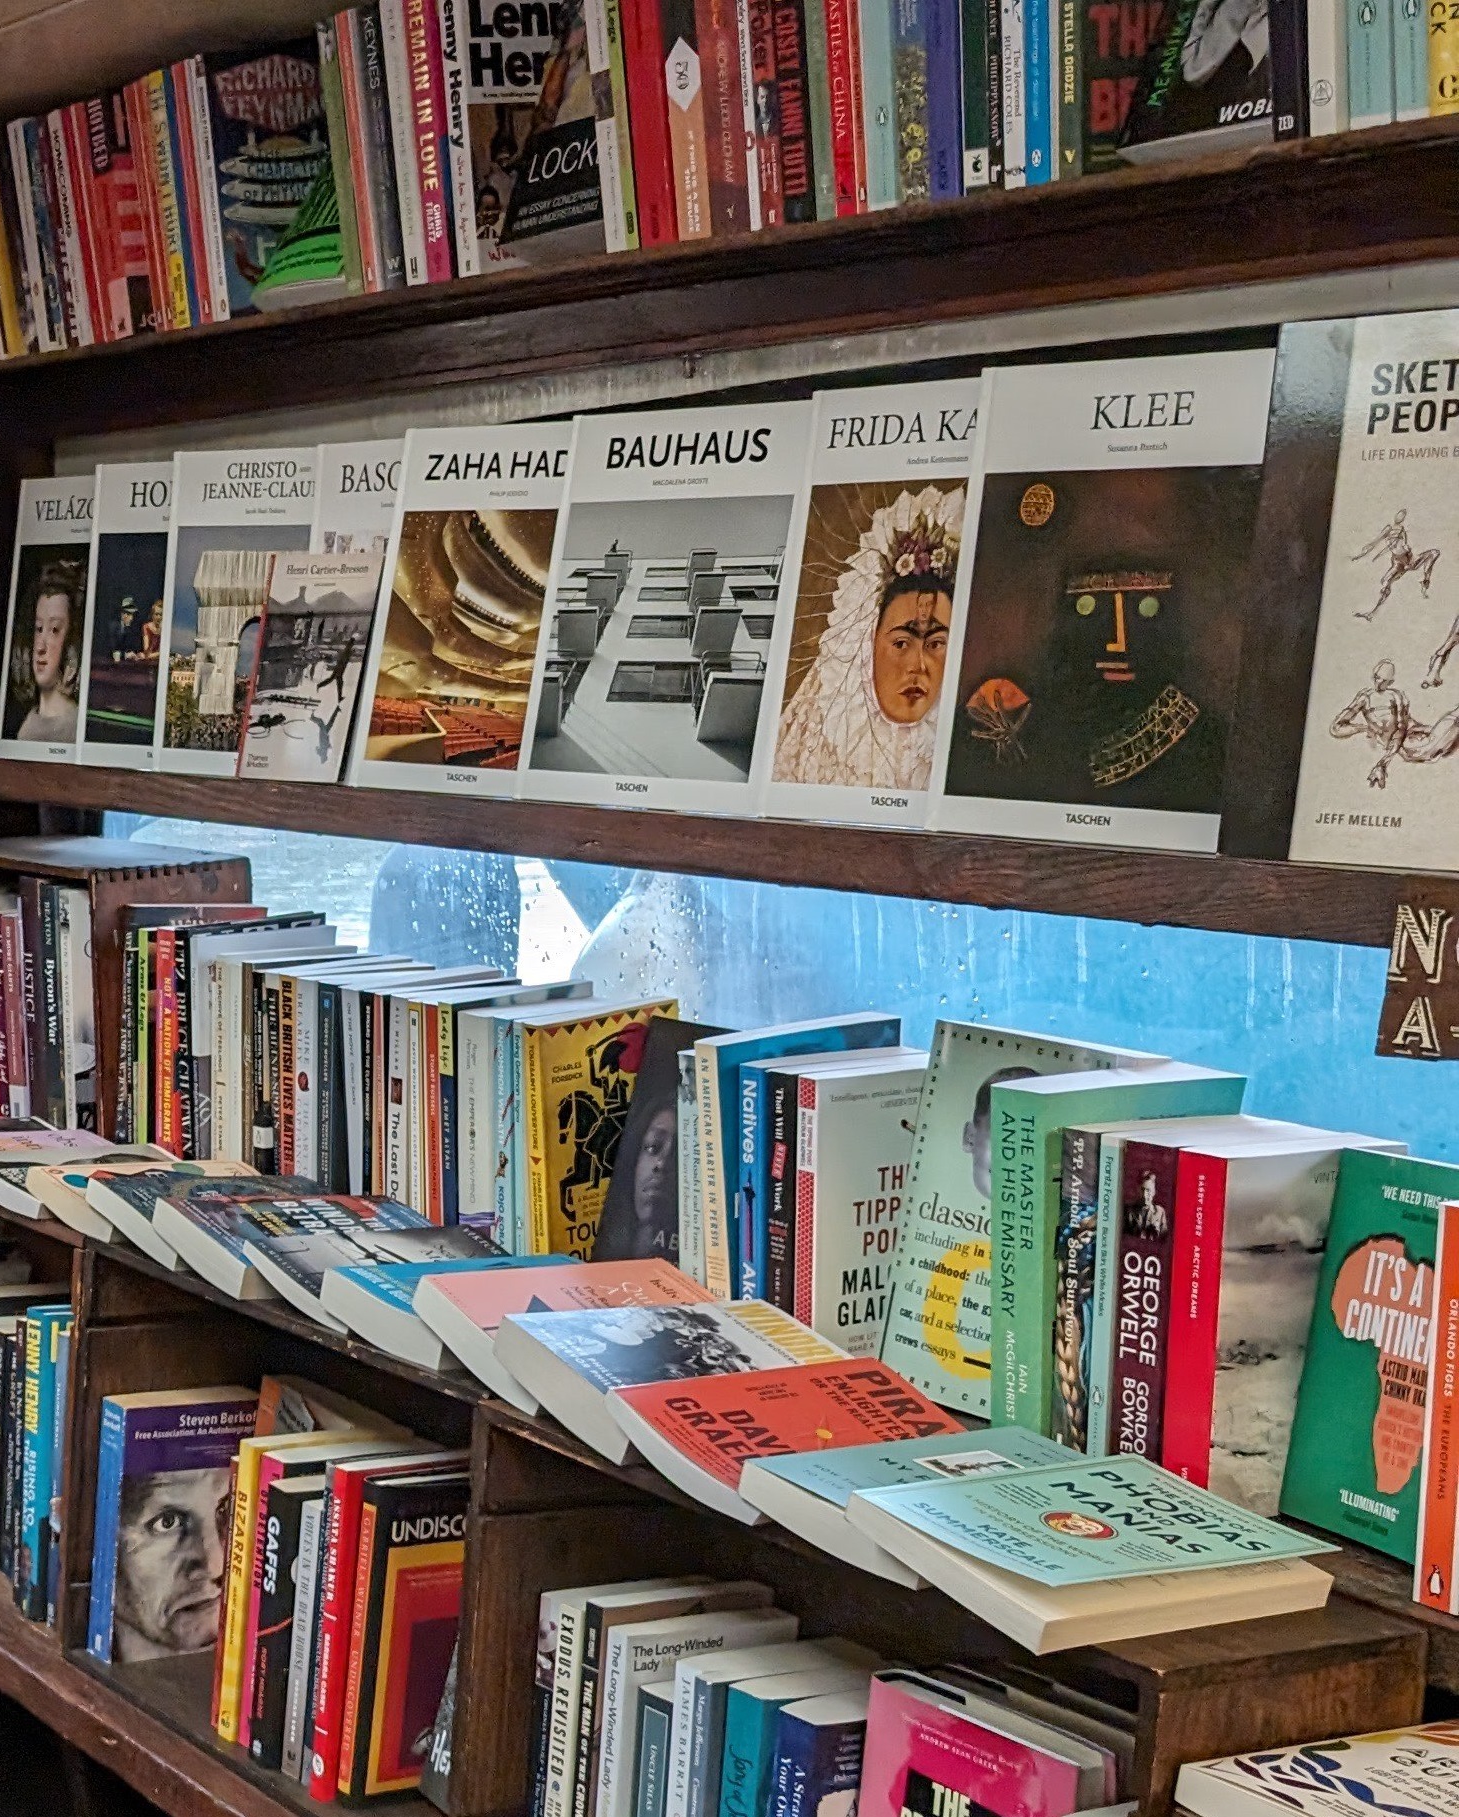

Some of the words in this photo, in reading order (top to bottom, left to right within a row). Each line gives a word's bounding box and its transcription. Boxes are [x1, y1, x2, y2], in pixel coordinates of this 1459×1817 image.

[775, 7, 800, 70] COSEY
[1063, 2, 1075, 53] STELLA
[363, 15, 381, 90] KEYNES
[1003, 35, 1012, 93] RICHARD
[1013, 49, 1022, 68] The
[1064, 55, 1076, 104] DADZIE
[415, 99, 433, 126] IN
[446, 68, 466, 149] Henry
[779, 78, 805, 136] FANNI
[833, 76, 849, 139] CHINA
[418, 132, 439, 191] LOVE
[527, 138, 600, 184] LOCK
[783, 140, 808, 195] TUTTI
[424, 201, 437, 244] FRANTZ
[433, 203, 443, 238] CHRIS
[1089, 390, 1197, 432] KLEE
[604, 427, 772, 470] BAUHAUS
[826, 411, 925, 450] FRIDA
[227, 460, 297, 479] CHRISTO
[423, 451, 502, 482] ZAHA
[1361, 449, 1385, 462] LIFE
[1388, 446, 1448, 461] DRAWING
[445, 772, 478, 784] TASCHEN
[614, 781, 649, 793] TASCHEN
[869, 795, 909, 809] TASCHEN
[1065, 812, 1112, 827] TASCHEN
[1314, 812, 1345, 826] JEFF
[1347, 813, 1404, 828] MELLEM
[43, 900, 52, 946] BEATON
[42, 958, 58, 1013] Byron's
[139, 956, 147, 989] Arms
[281, 980, 292, 1021] BLACK
[47, 1015, 59, 1046] War
[137, 1006, 147, 1032] Legs
[162, 1017, 172, 1058] NATION
[282, 1024, 293, 1073] BRITISH
[303, 1029, 311, 1065] MIKE
[513, 1034, 521, 1059] Erving
[162, 1059, 172, 1073] OF
[497, 1025, 506, 1096] UNCOMMON
[514, 1060, 522, 1097] Goffman
[550, 1071, 583, 1085] FORSDICK
[551, 1061, 583, 1074] CHARLES
[700, 1056, 709, 1073] AN
[162, 1075, 172, 1143] IMMIGRANTS
[282, 1076, 294, 1110] LIVES
[701, 1077, 714, 1136] AMERICAN
[774, 1087, 785, 1114] That
[390, 1111, 401, 1142] The
[443, 1097, 451, 1132] AHMET
[741, 1079, 757, 1164] Natives
[774, 1116, 785, 1140] Will
[1001, 1110, 1018, 1160] AND
[1019, 1114, 1036, 1160] THE
[390, 1144, 400, 1177] Last
[443, 1137, 451, 1171] ALTAN
[1070, 1137, 1085, 1172] P.P.
[1103, 1155, 1114, 1187] Frantz
[497, 1185, 506, 1213] KOJO
[707, 1191, 717, 1205] IN
[773, 1181, 783, 1212] Work
[1002, 1165, 1018, 1201] HIS
[1069, 1174, 1083, 1228] Arnold
[1399, 1188, 1422, 1206] NEED
[1019, 1164, 1035, 1251] MASTER
[1101, 1188, 1113, 1222] Fanon
[709, 1209, 720, 1248] PERSIA
[914, 1227, 970, 1258] including
[973, 1244, 985, 1258] in
[999, 1204, 1016, 1319] EMISSARY
[1066, 1238, 1082, 1274] Soul
[1191, 1245, 1202, 1279] ARCTIC
[904, 1278, 916, 1291] of
[961, 1296, 979, 1312] the
[1363, 1249, 1408, 1302] IT'S
[1408, 1262, 1426, 1309] A
[1063, 1278, 1078, 1346] Survivor
[1118, 1251, 1142, 1359] ORWELL
[1138, 1255, 1161, 1366] GEORGE
[1189, 1281, 1200, 1319] DREAMS
[914, 1311, 935, 1327] and
[1446, 1298, 1459, 1359] ORLANDO
[25, 1318, 42, 1374] LENNY
[894, 1332, 919, 1349] crews
[920, 1341, 957, 1361] essays
[1017, 1363, 1028, 1395] IAN
[1381, 1358, 1409, 1385] ASTRID
[1444, 1363, 1456, 1398] FIGES
[24, 1377, 39, 1434] HENRY
[1383, 1378, 1411, 1403] CHINNY
[179, 1414, 218, 1428] Steven
[1442, 1403, 1452, 1425] THE
[135, 1431, 152, 1440] Free
[26, 1449, 37, 1501] RISING
[1438, 1429, 1452, 1500] EUROPEANS
[330, 1496, 342, 1544] ASSATA
[1048, 1481, 1213, 1554] MANIAS
[1087, 1470, 1272, 1553] PHOBIAS
[1126, 1504, 1177, 1527] AND
[1146, 1481, 1183, 1500] THE
[1180, 1497, 1228, 1522] BOOK
[1225, 1518, 1259, 1534] OF
[232, 1490, 248, 1578] BIZARRE
[303, 1514, 316, 1554] VOICES
[357, 1517, 372, 1582] GABRIELA
[913, 1500, 1066, 1572] SUMMERSCALE
[977, 1523, 1034, 1549] KATE
[263, 1515, 281, 1596] GAFFS
[300, 1576, 312, 1596] THE
[326, 1547, 338, 1602] SHAKUR
[352, 1586, 365, 1637] WIENER
[610, 1643, 622, 1668] The
[632, 1644, 654, 1658] The
[655, 1636, 724, 1657] Long-Winded
[633, 1658, 661, 1673] Lady
[342, 1650, 360, 1752] UNDISCOVERED
[583, 1679, 594, 1708] THE
[680, 1677, 692, 1732] JAMES
[580, 1709, 592, 1737] MAN
[603, 1669, 619, 1756] Long-Winded
[550, 1686, 570, 1777] REVISITED
[601, 1757, 614, 1789] Lady
[647, 1743, 658, 1783] UNCLE
[675, 1737, 687, 1803] BARRAT
[779, 1757, 792, 1791] Your
[794, 1765, 806, 1778] A
[645, 1782, 655, 1812] SILAS
[931, 1781, 971, 1817] THE
